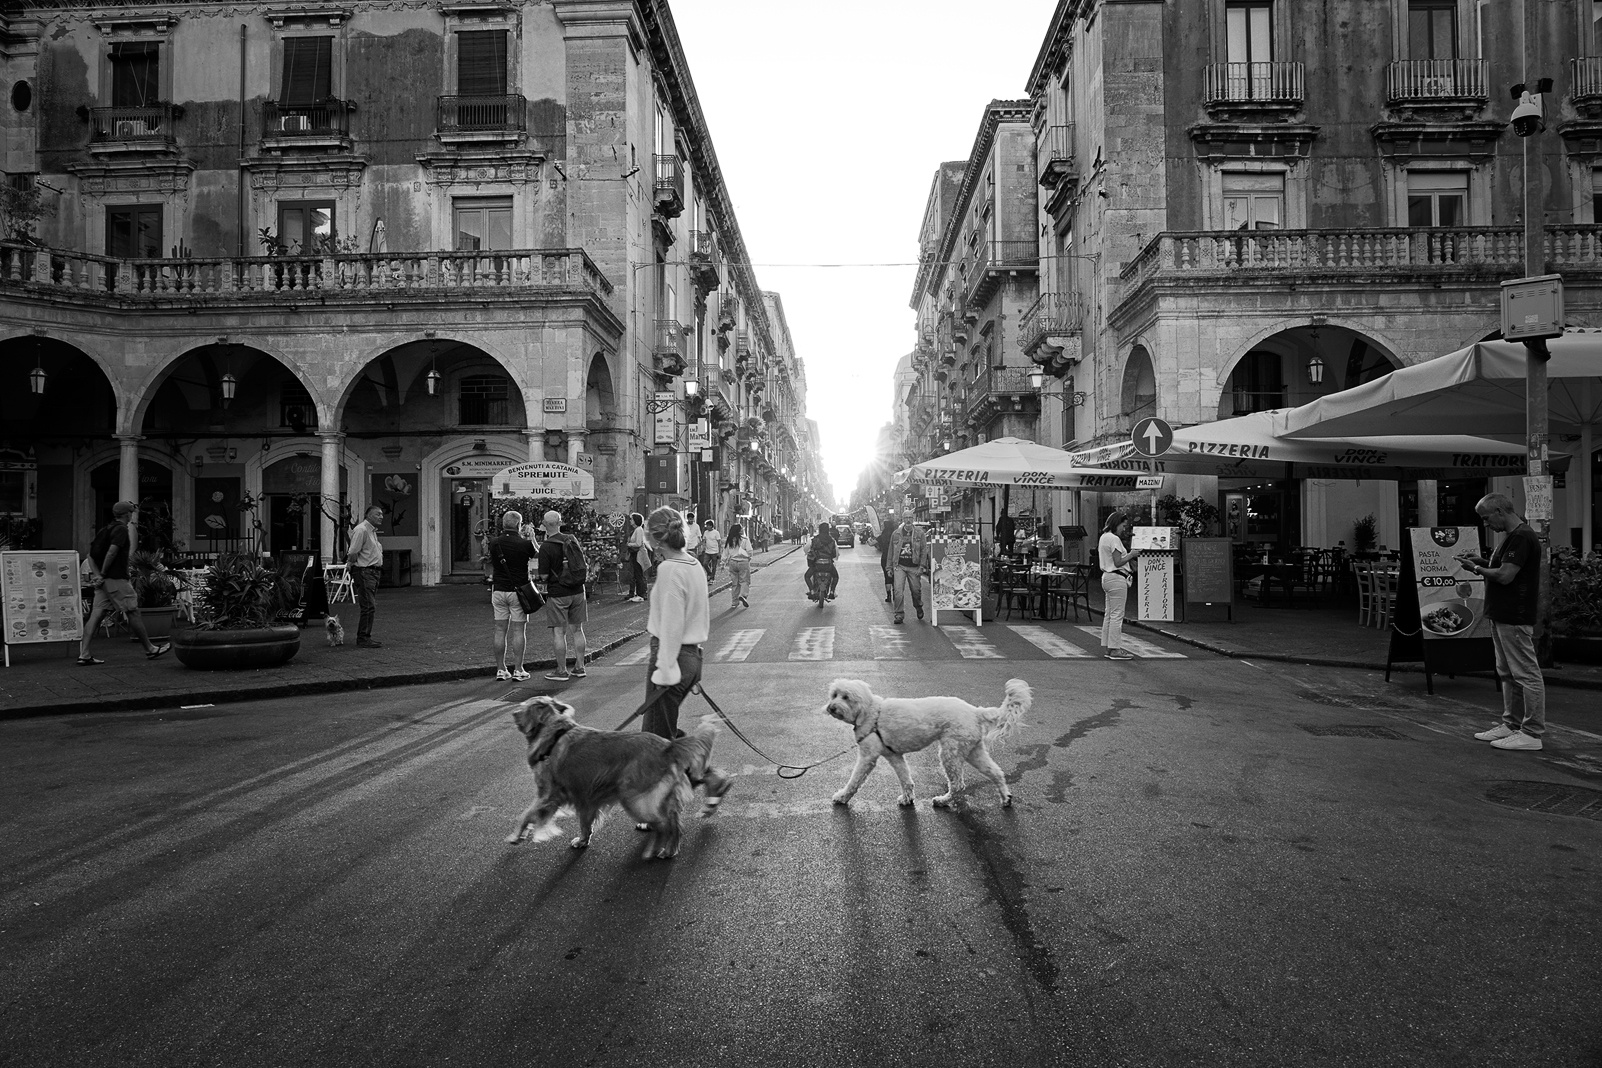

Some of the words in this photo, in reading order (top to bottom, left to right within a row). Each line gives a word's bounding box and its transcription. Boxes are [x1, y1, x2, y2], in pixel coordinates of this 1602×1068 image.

[1188, 442, 1270, 458] PIZZERIA
[1344, 448, 1378, 456] DON
[1452, 454, 1527, 467] TRATTORI
[508, 463, 544, 474] BENVENUTI
[551, 464, 579, 474] CATANIA
[517, 471, 569, 479] SPREMUTE
[925, 469, 989, 482] PIZZERIA
[1013, 474, 1056, 485] VINCÈ
[1080, 475, 1138, 487] TRATTORI
[530, 487, 556, 495] JUICE
[940, 494, 949, 506] P
[1419, 550, 1440, 558] PASTA
